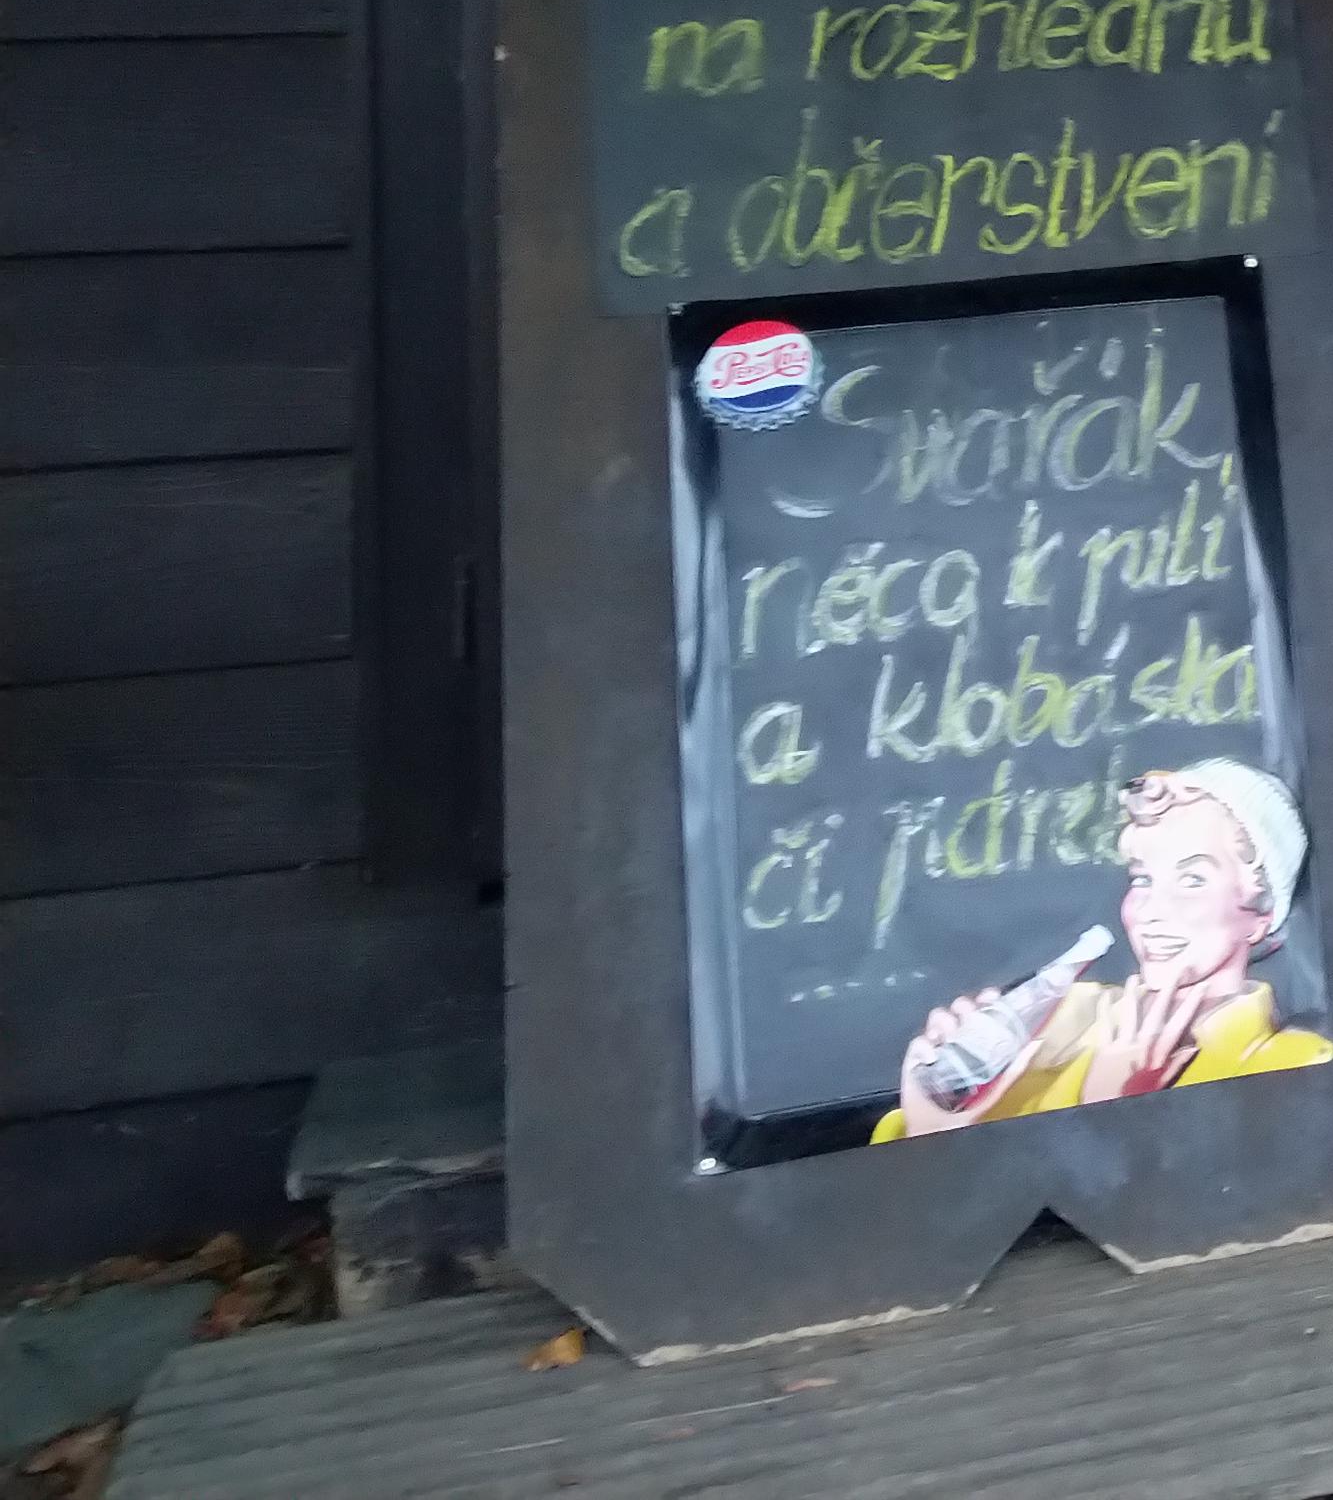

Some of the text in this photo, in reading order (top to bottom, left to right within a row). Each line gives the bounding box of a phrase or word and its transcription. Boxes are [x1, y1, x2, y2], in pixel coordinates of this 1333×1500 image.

[644, 17, 765, 95] na
[617, 106, 1284, 279] a občerstvení
[739, 701, 823, 784] a
